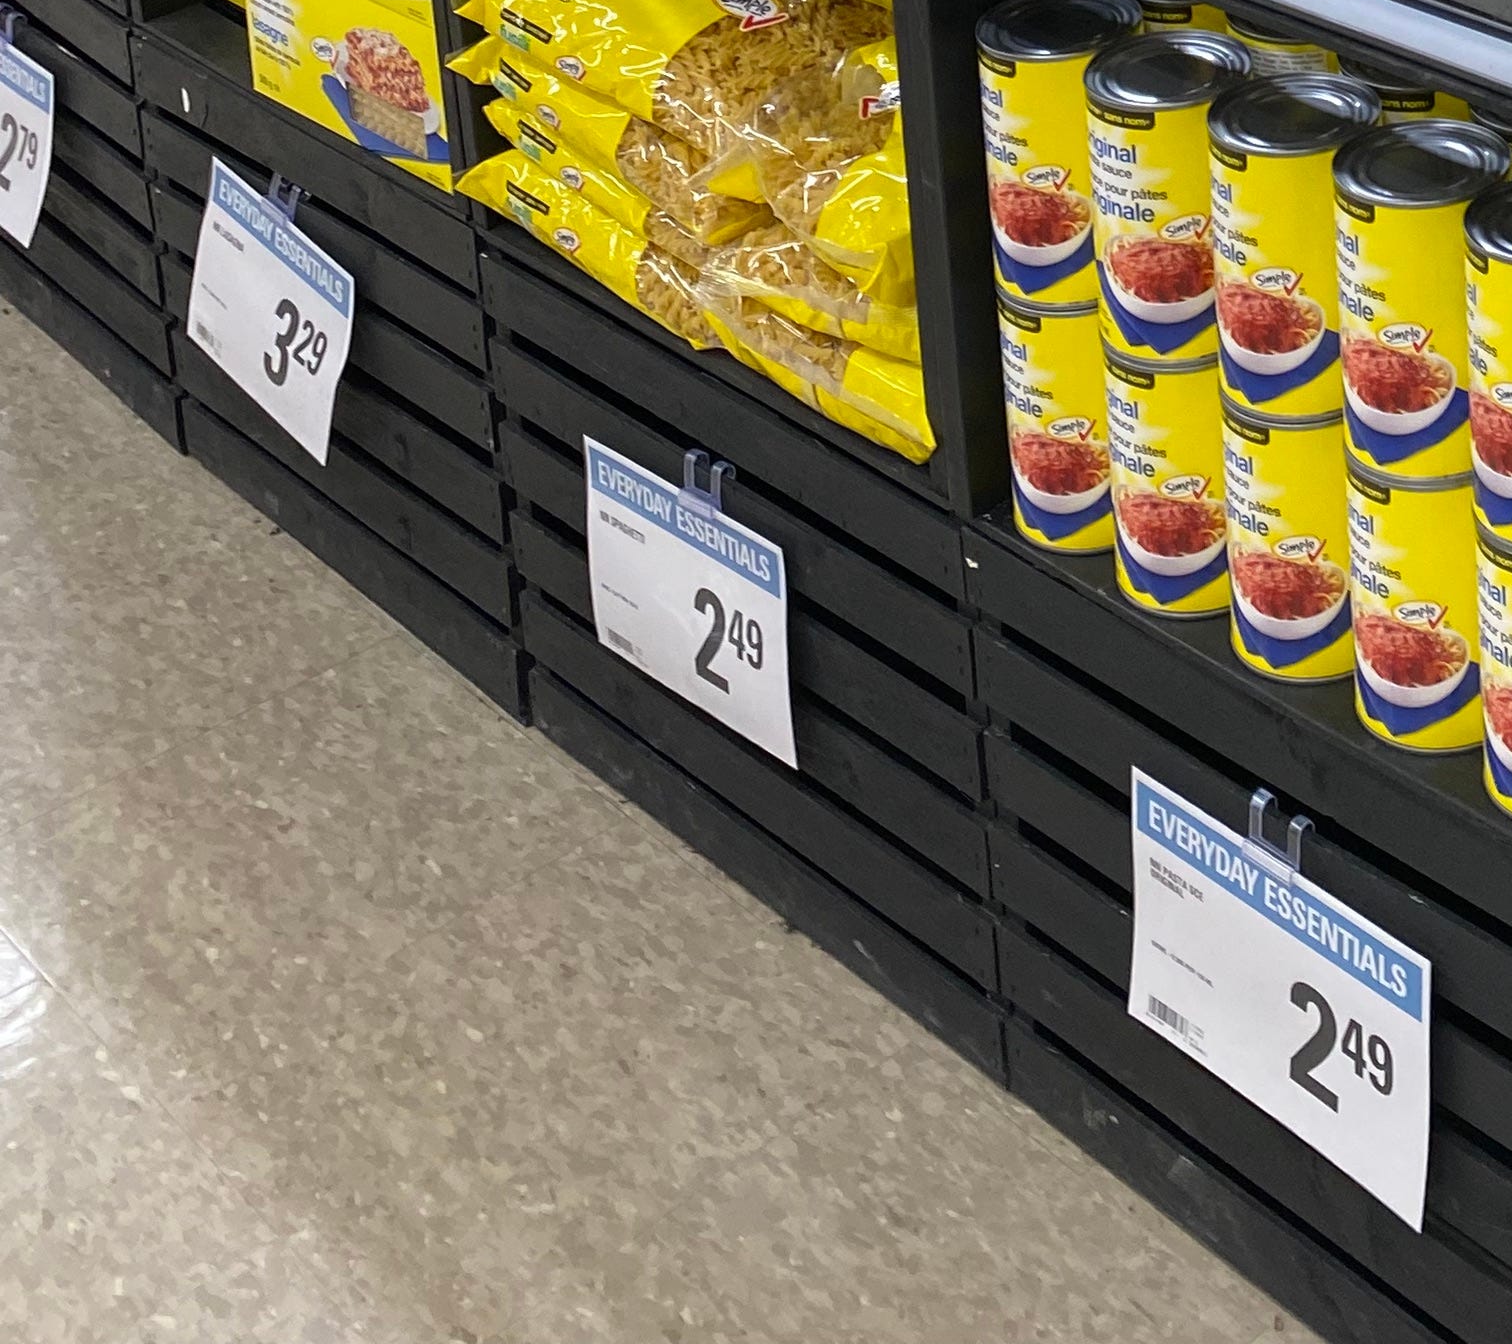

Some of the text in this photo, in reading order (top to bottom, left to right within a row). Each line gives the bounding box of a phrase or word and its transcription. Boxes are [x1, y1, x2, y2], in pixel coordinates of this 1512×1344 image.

[219, 179, 275, 243] EVERYDAY
[275, 226, 344, 304] ESSENTIALS
[1164, 216, 1202, 239] Simple
[597, 459, 671, 520] EVERYDAY
[675, 505, 771, 583] ESSENTIALS
[1148, 799, 1260, 896] EVERYDAY
[1264, 879, 1409, 999] ESSENTIALS
